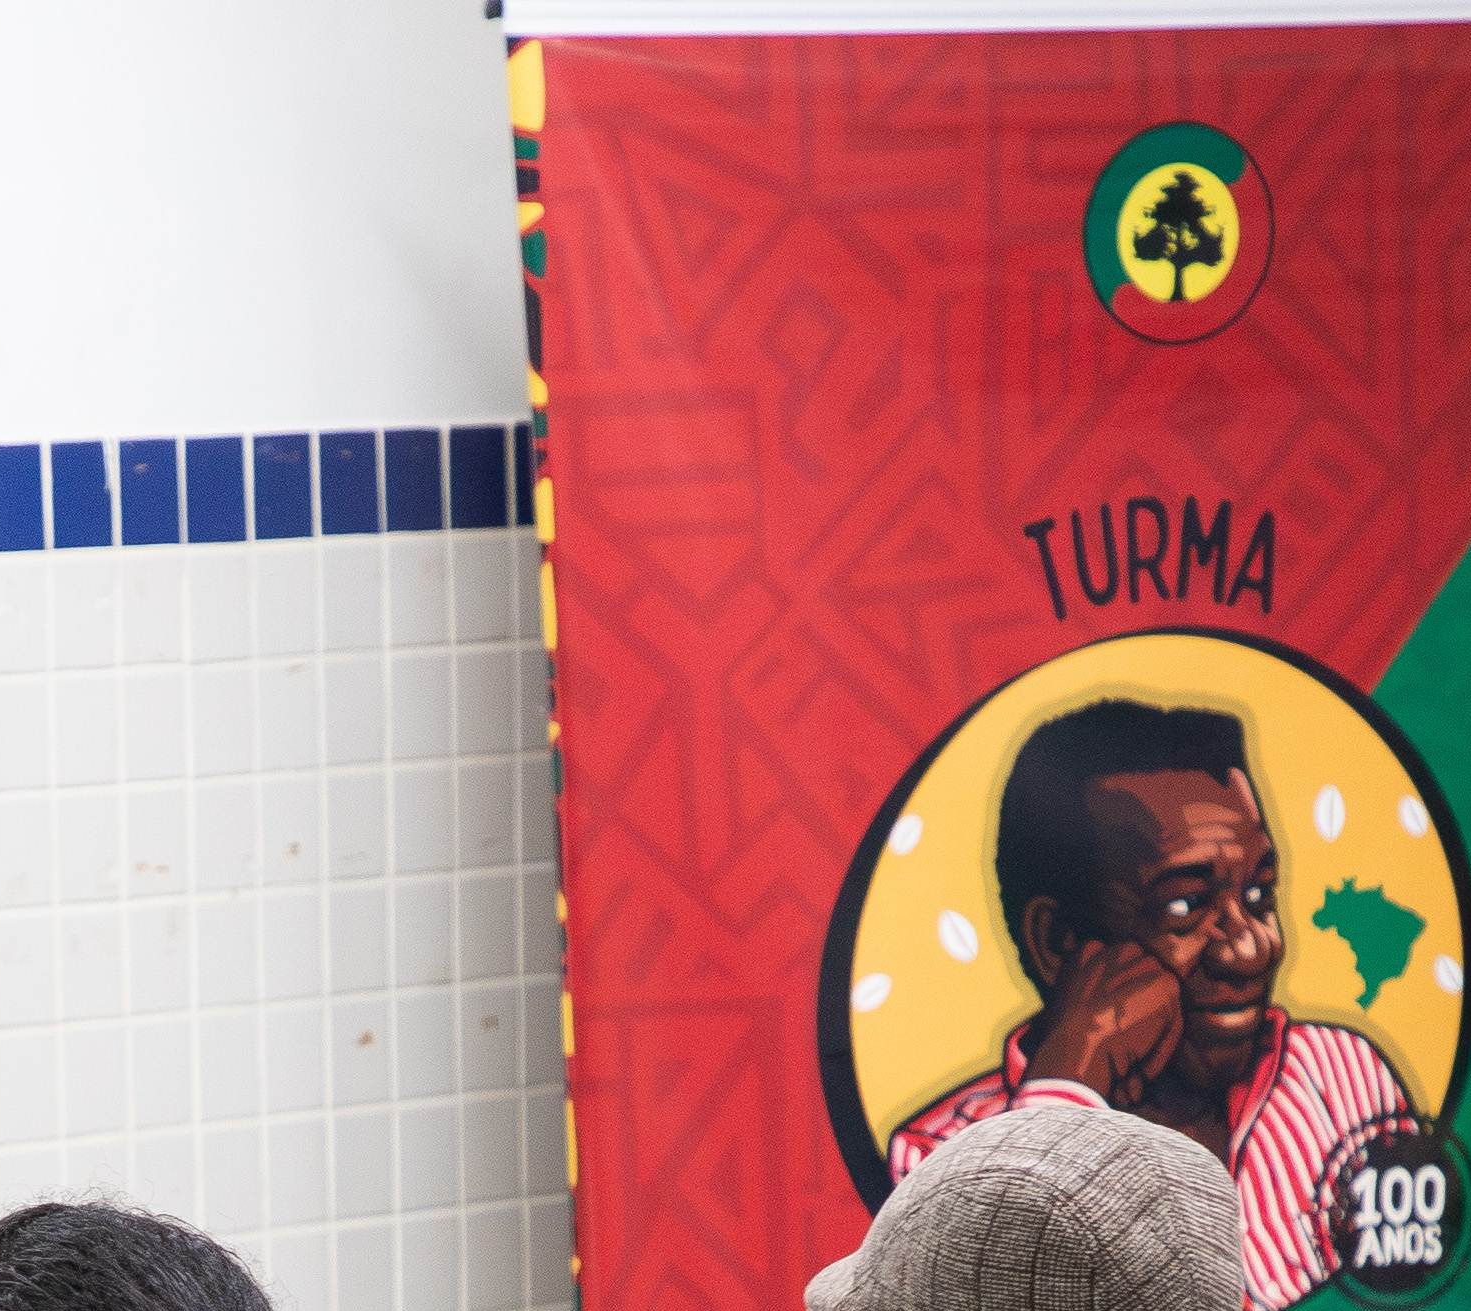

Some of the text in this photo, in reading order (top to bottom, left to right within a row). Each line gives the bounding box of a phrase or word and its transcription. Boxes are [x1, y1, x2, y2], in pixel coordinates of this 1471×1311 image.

[1023, 494, 1276, 621] TURMA
[1352, 1164, 1446, 1228] 100
[1354, 1221, 1443, 1268] ANOS
